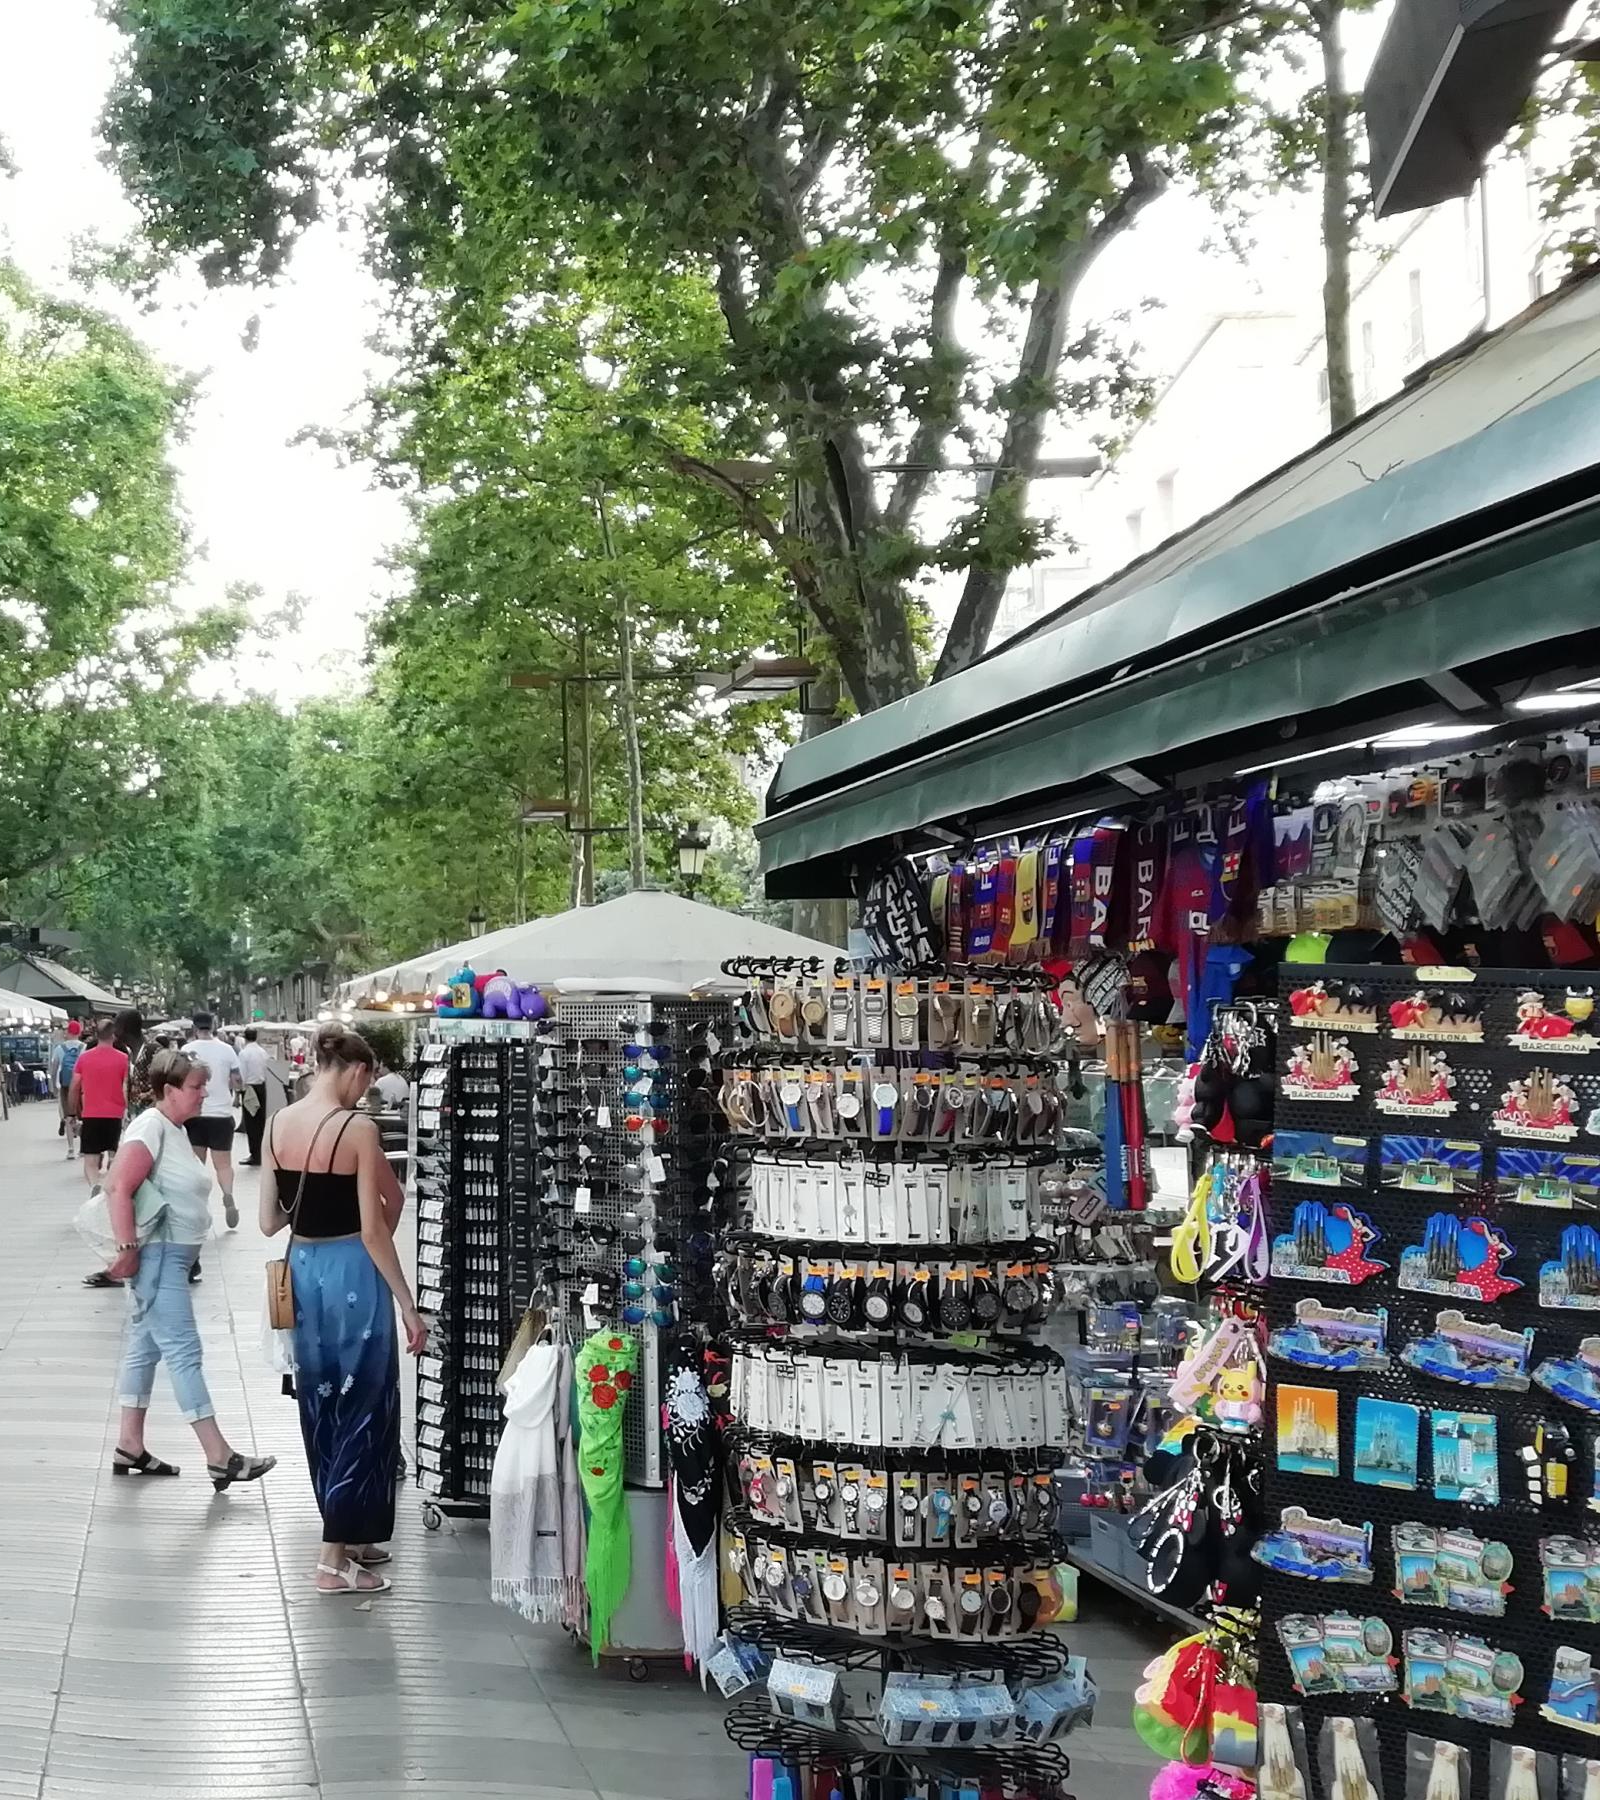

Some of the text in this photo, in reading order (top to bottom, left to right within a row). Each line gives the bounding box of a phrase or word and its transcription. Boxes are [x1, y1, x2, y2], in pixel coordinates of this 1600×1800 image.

[1302, 1019, 1363, 1032] BARCELONA
[1404, 1032, 1468, 1042] BARCELONA
[1521, 1041, 1587, 1052] BARCELONA
[1291, 1090, 1351, 1099] BARCELONA
[1385, 1105, 1448, 1115] BARCELONA
[1503, 1126, 1568, 1140] BARCELONA
